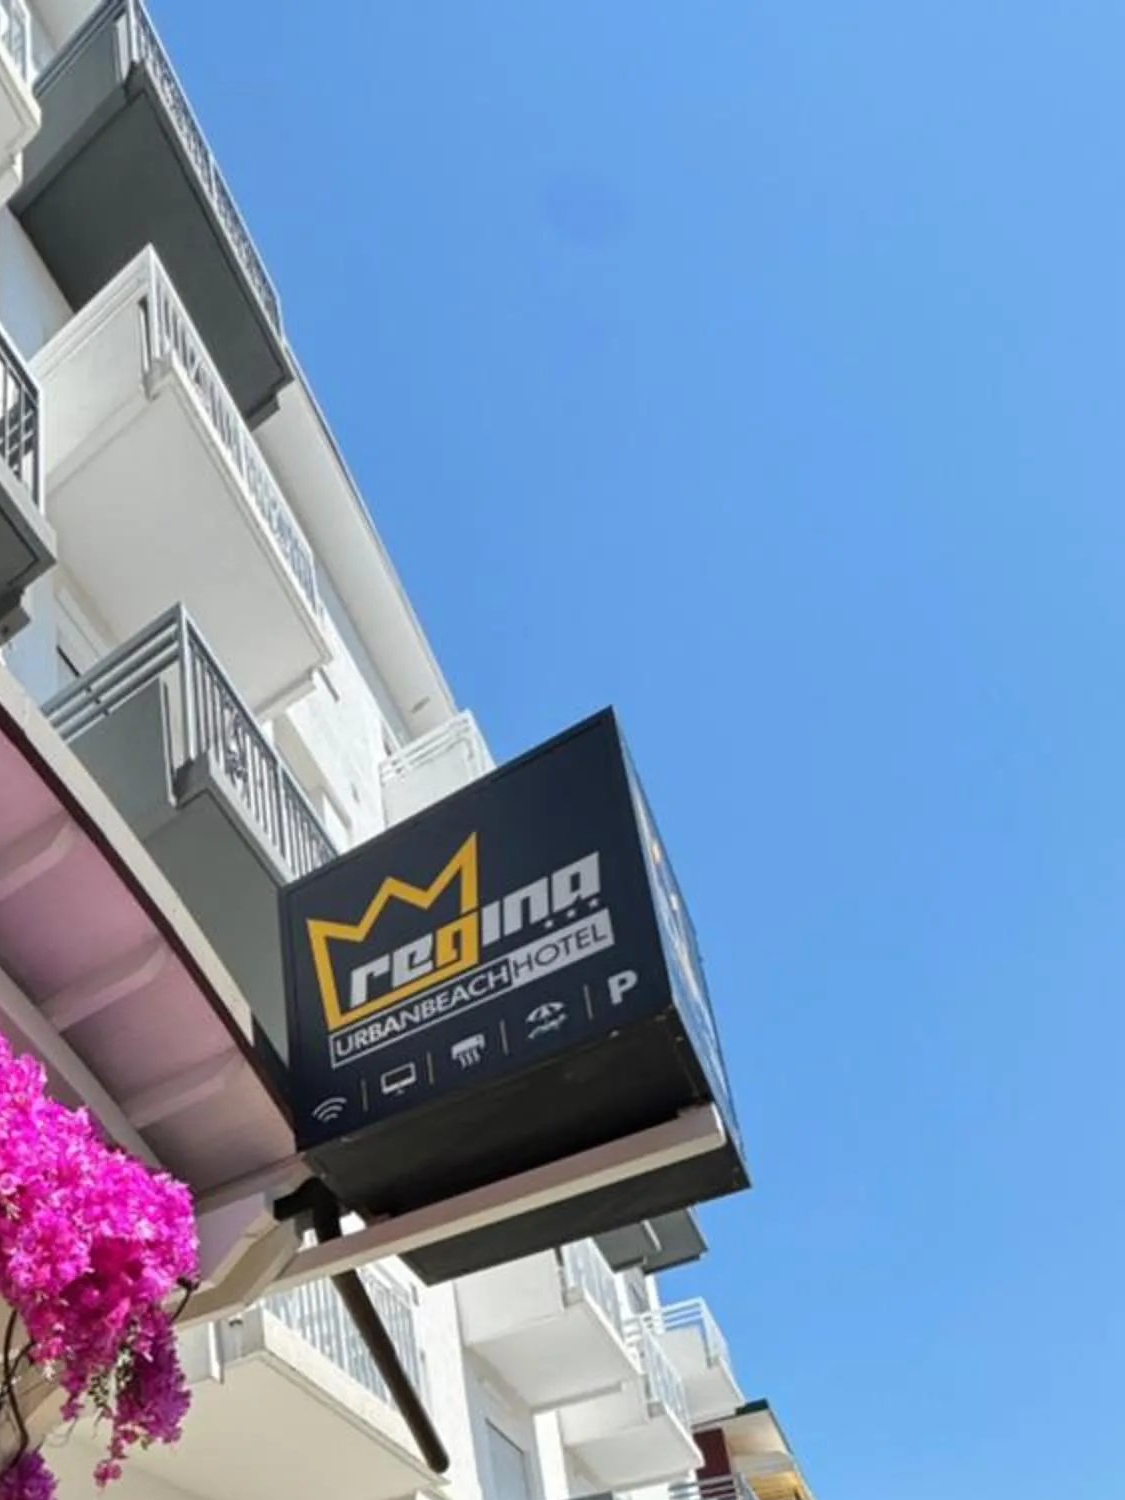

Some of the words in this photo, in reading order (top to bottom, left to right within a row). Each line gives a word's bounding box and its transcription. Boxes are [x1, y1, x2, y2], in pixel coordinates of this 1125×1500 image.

[349, 852, 601, 1009] regina
[512, 922, 608, 978] HOTEL
[607, 969, 639, 1006] P
